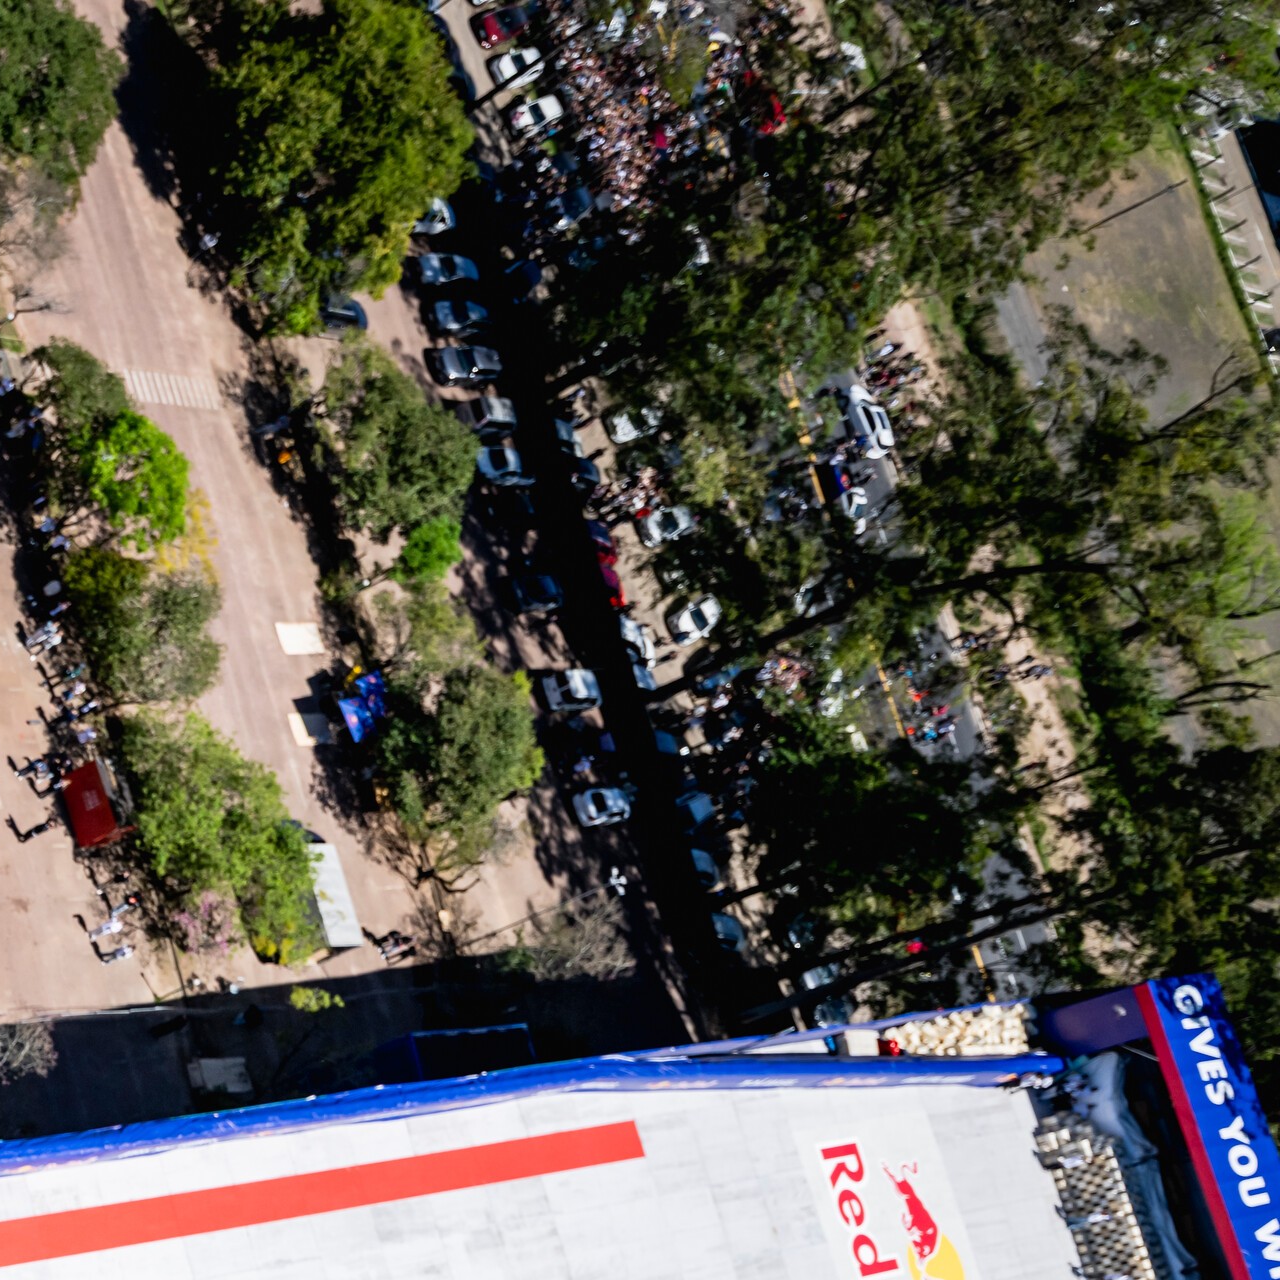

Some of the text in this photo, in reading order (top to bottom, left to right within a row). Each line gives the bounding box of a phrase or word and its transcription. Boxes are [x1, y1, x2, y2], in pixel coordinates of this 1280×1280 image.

[1173, 984, 1235, 1106] GIVES
[1218, 1115, 1271, 1208] YOU
[820, 1143, 899, 1277] Red
